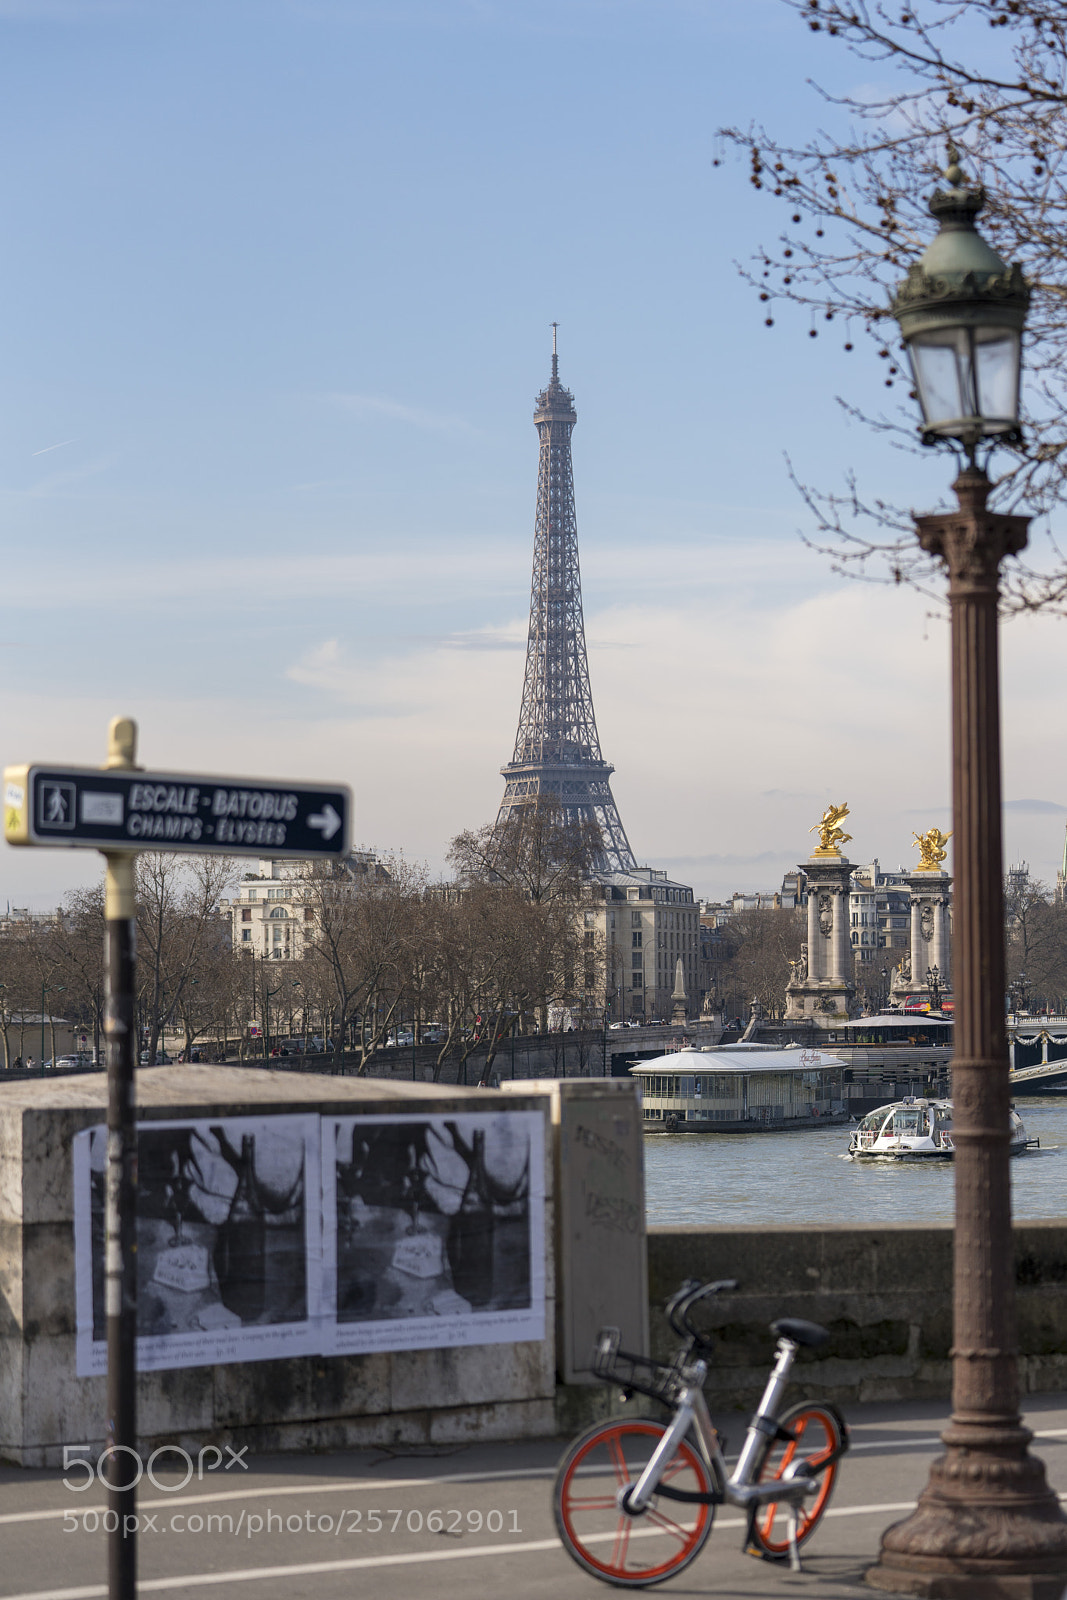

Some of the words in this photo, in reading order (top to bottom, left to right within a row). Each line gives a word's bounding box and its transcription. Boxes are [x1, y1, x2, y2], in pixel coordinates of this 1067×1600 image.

[128, 783, 200, 814] ESCALE
[212, 789, 298, 820] BATOBUS
[127, 813, 203, 840] CHAMPS
